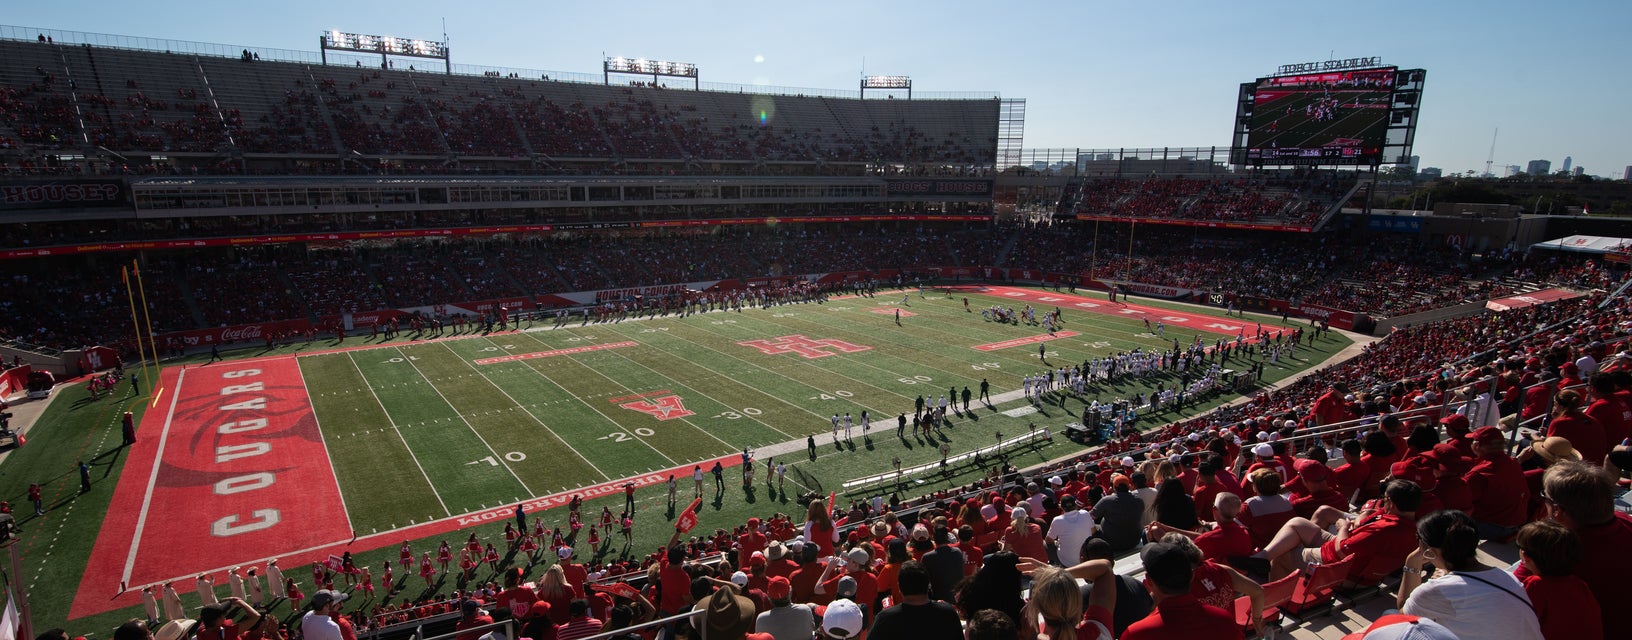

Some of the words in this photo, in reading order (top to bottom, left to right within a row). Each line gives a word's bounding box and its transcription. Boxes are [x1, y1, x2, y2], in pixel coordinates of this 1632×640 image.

[1323, 57, 1376, 71] STADIUM
[3, 183, 119, 204] HOUSE?
[596, 288, 641, 301] HOUSTON
[644, 284, 687, 298] COUGARS
[1210, 293, 1223, 304] 40
[222, 326, 262, 341] Coca-Cola
[897, 375, 933, 385] 50
[820, 390, 854, 401] 40
[722, 407, 763, 420] 30
[607, 427, 655, 443] 20
[210, 368, 282, 538] COUGARS
[478, 452, 527, 467] 10
